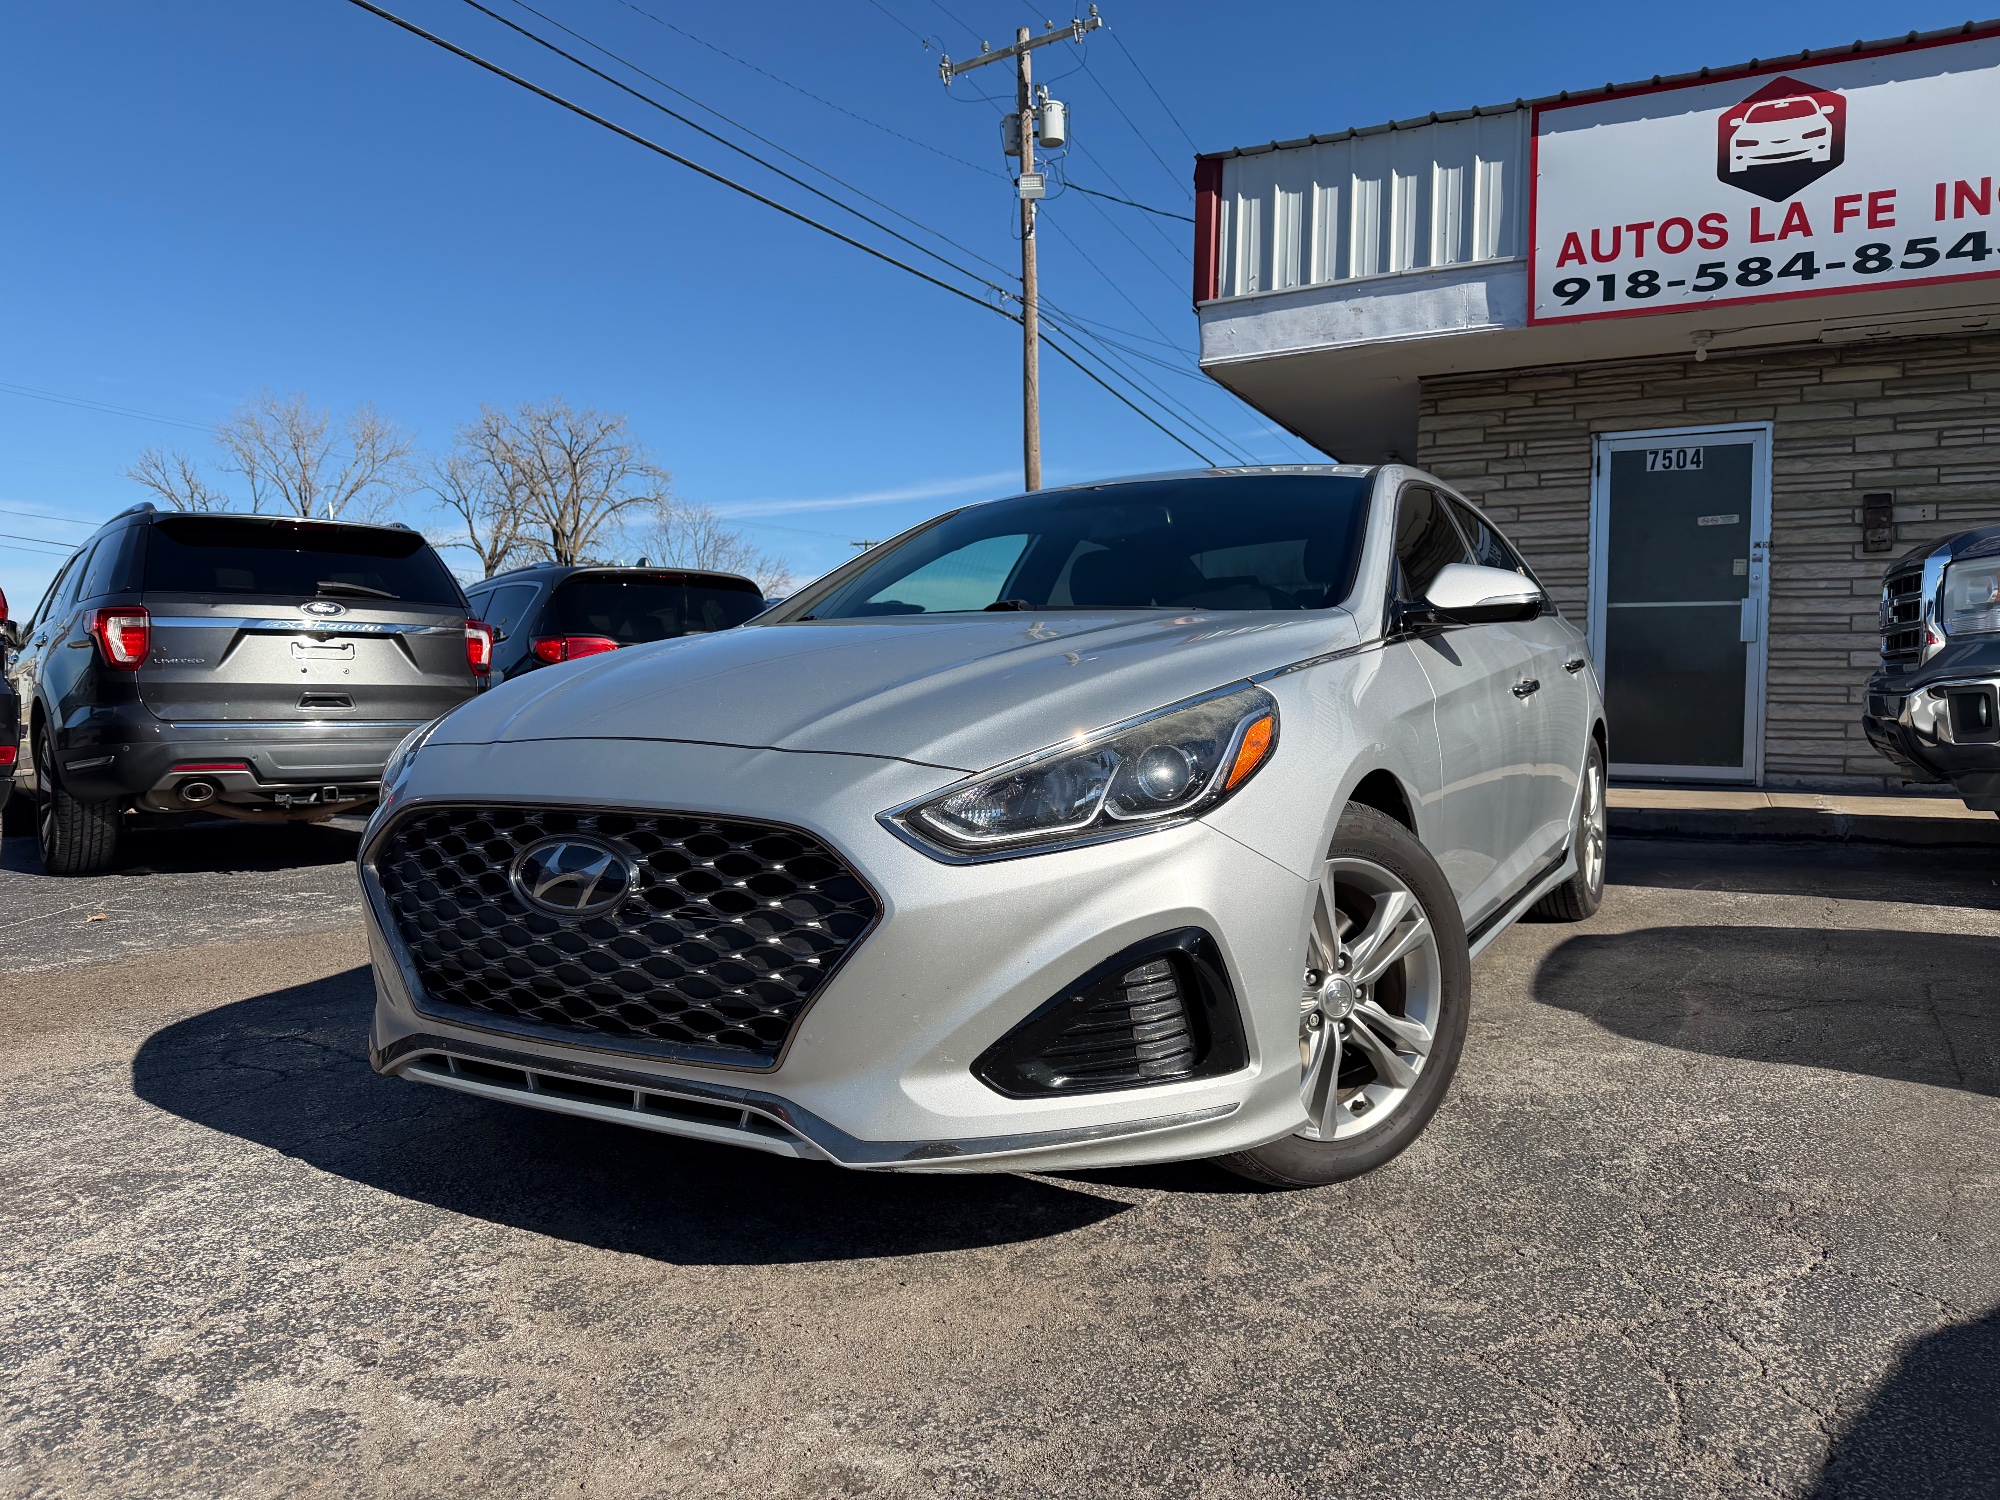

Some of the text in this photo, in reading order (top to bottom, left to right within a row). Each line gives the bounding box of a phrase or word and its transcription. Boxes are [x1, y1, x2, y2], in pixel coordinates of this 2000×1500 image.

[1556, 176, 2000, 268] AUTOS LA FE IN
[1552, 230, 2000, 306] 918-584-854
[1648, 448, 1702, 470] 7504
[311, 602, 336, 613] Ford
